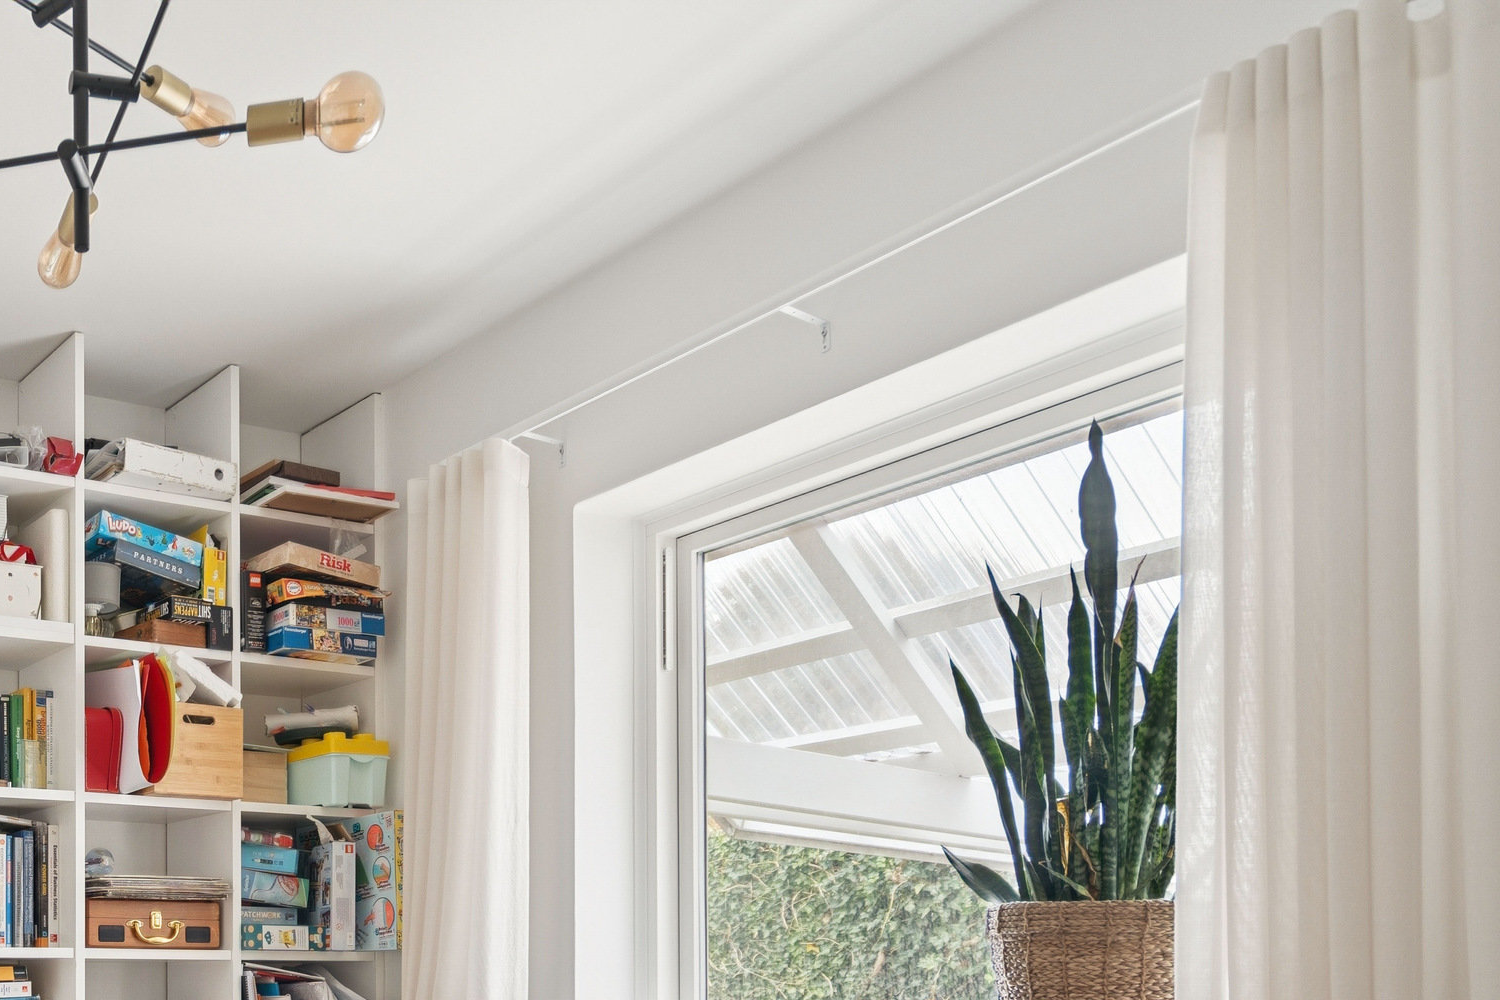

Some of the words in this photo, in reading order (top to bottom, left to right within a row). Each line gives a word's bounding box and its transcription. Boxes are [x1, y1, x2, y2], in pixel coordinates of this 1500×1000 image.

[107, 516, 138, 537] LUDO
[133, 551, 183, 575] PARTNERS
[319, 553, 352, 573] Risk
[174, 604, 198, 617] HAPPENS
[198, 604, 212, 619] SHIT
[337, 616, 353, 627] 1000
